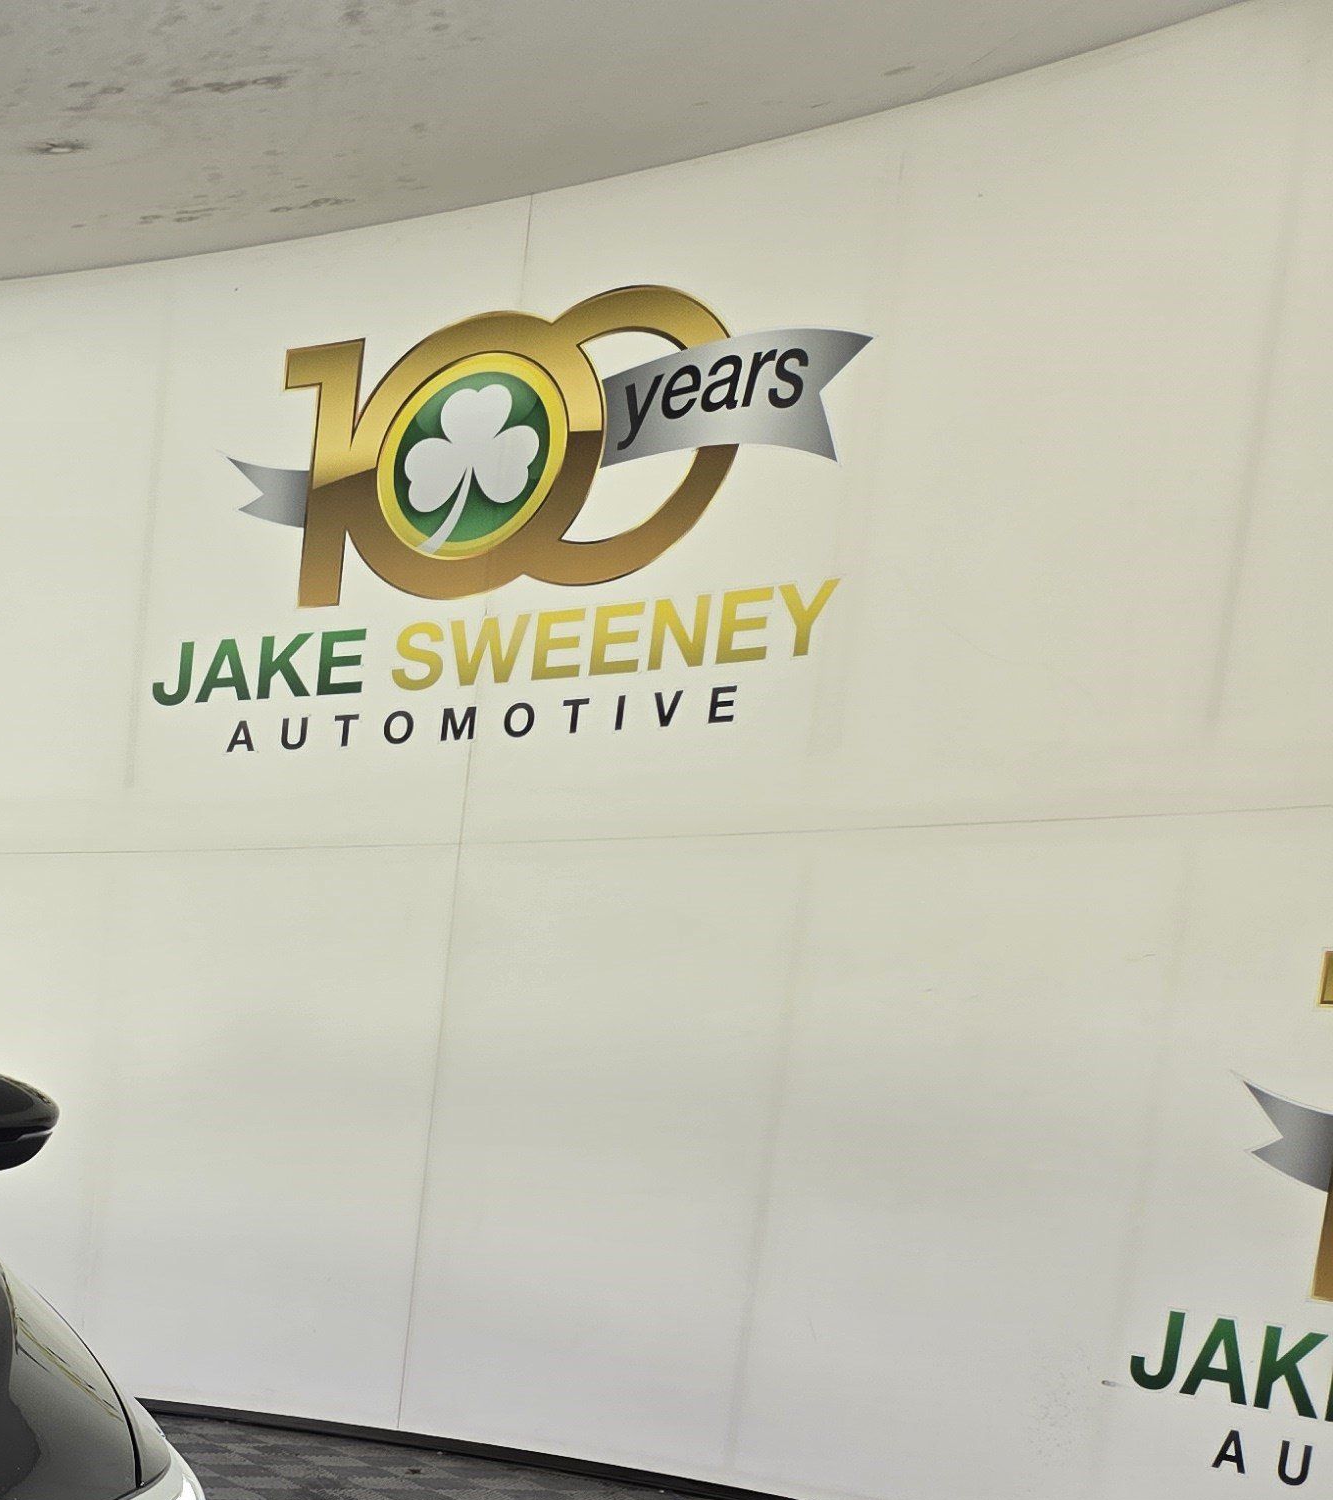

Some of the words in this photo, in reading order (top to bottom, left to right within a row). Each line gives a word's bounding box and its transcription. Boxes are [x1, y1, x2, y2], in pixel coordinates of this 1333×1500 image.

[617, 345, 808, 450] years
[152, 629, 366, 706] JAKE
[391, 577, 841, 692] SWEENEY
[227, 685, 738, 752] AUTOMOTIVE
[1130, 1311, 1333, 1422] JAK
